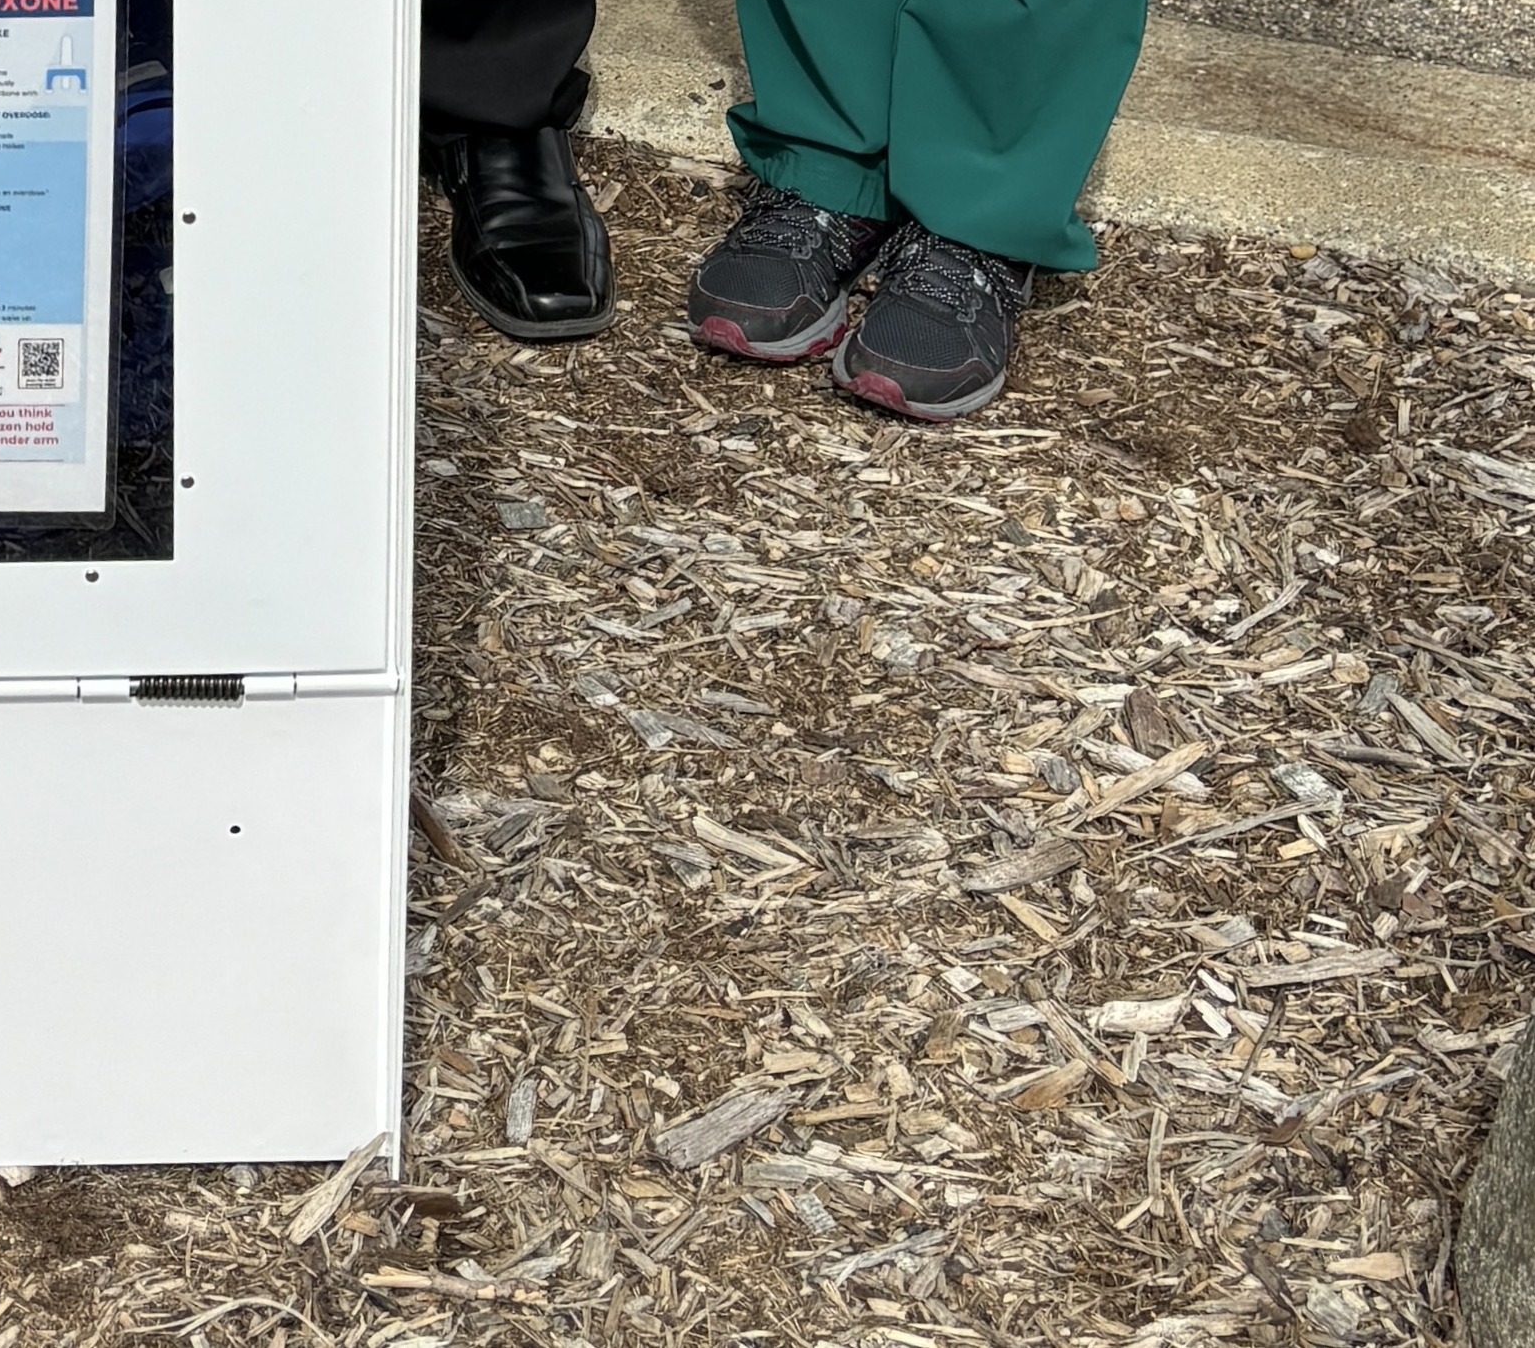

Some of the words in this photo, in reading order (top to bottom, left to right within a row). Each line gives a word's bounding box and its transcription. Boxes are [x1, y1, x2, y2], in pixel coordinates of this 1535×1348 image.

[18, 408, 52, 418] think
[25, 422, 54, 431] hold
[33, 437, 59, 445] arm
